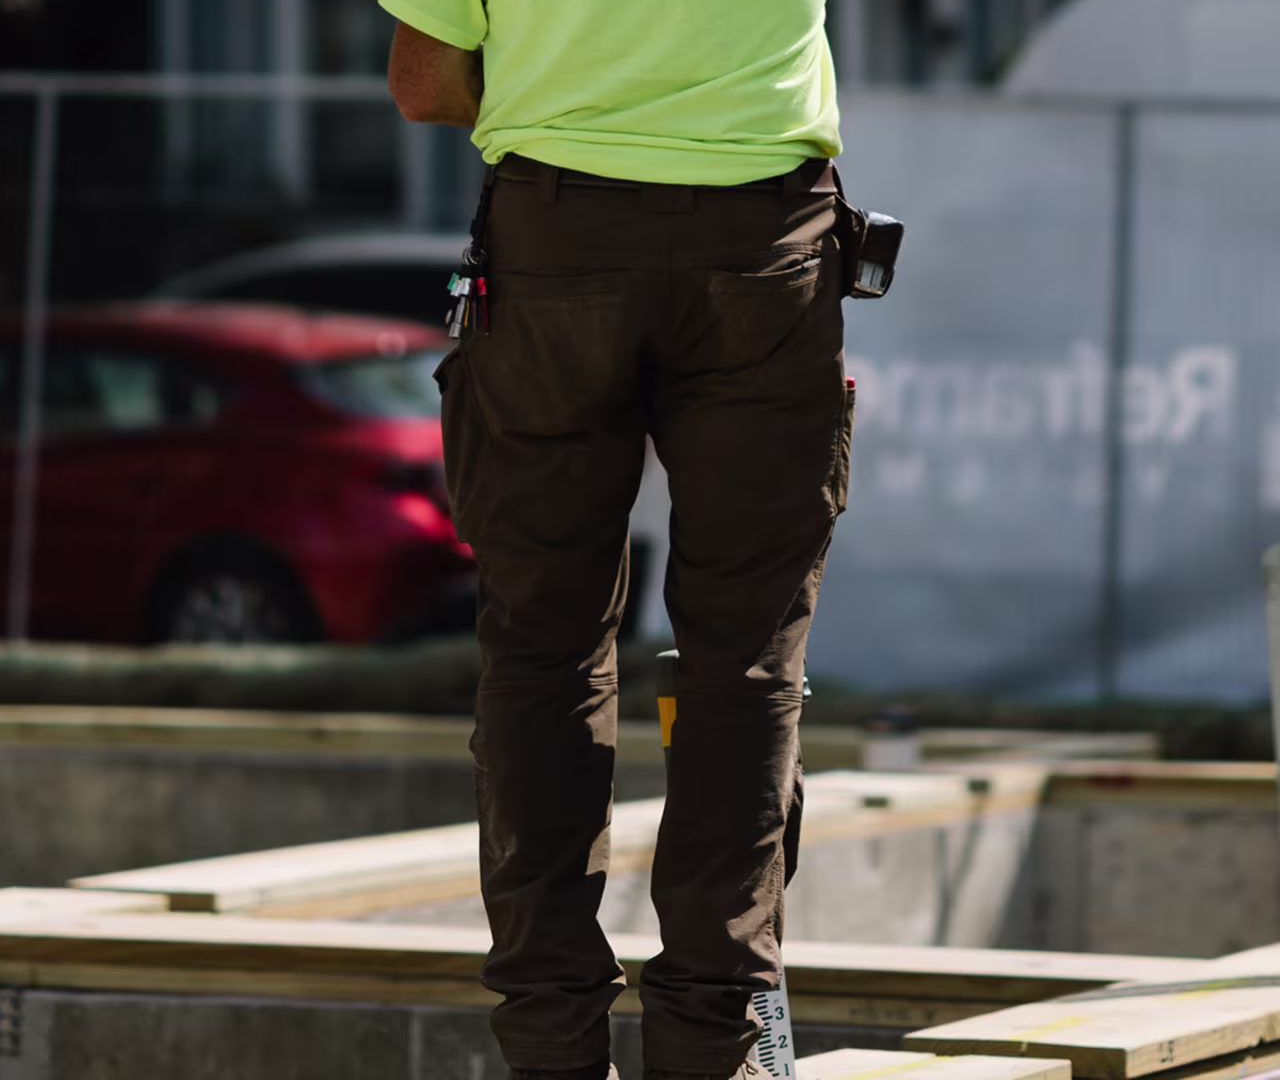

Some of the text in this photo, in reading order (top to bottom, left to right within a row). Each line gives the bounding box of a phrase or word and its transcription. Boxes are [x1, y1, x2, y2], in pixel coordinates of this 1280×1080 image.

[775, 1006, 784, 1020] 3
[778, 1035, 788, 1049] 2
[785, 1063, 790, 1077] 1
